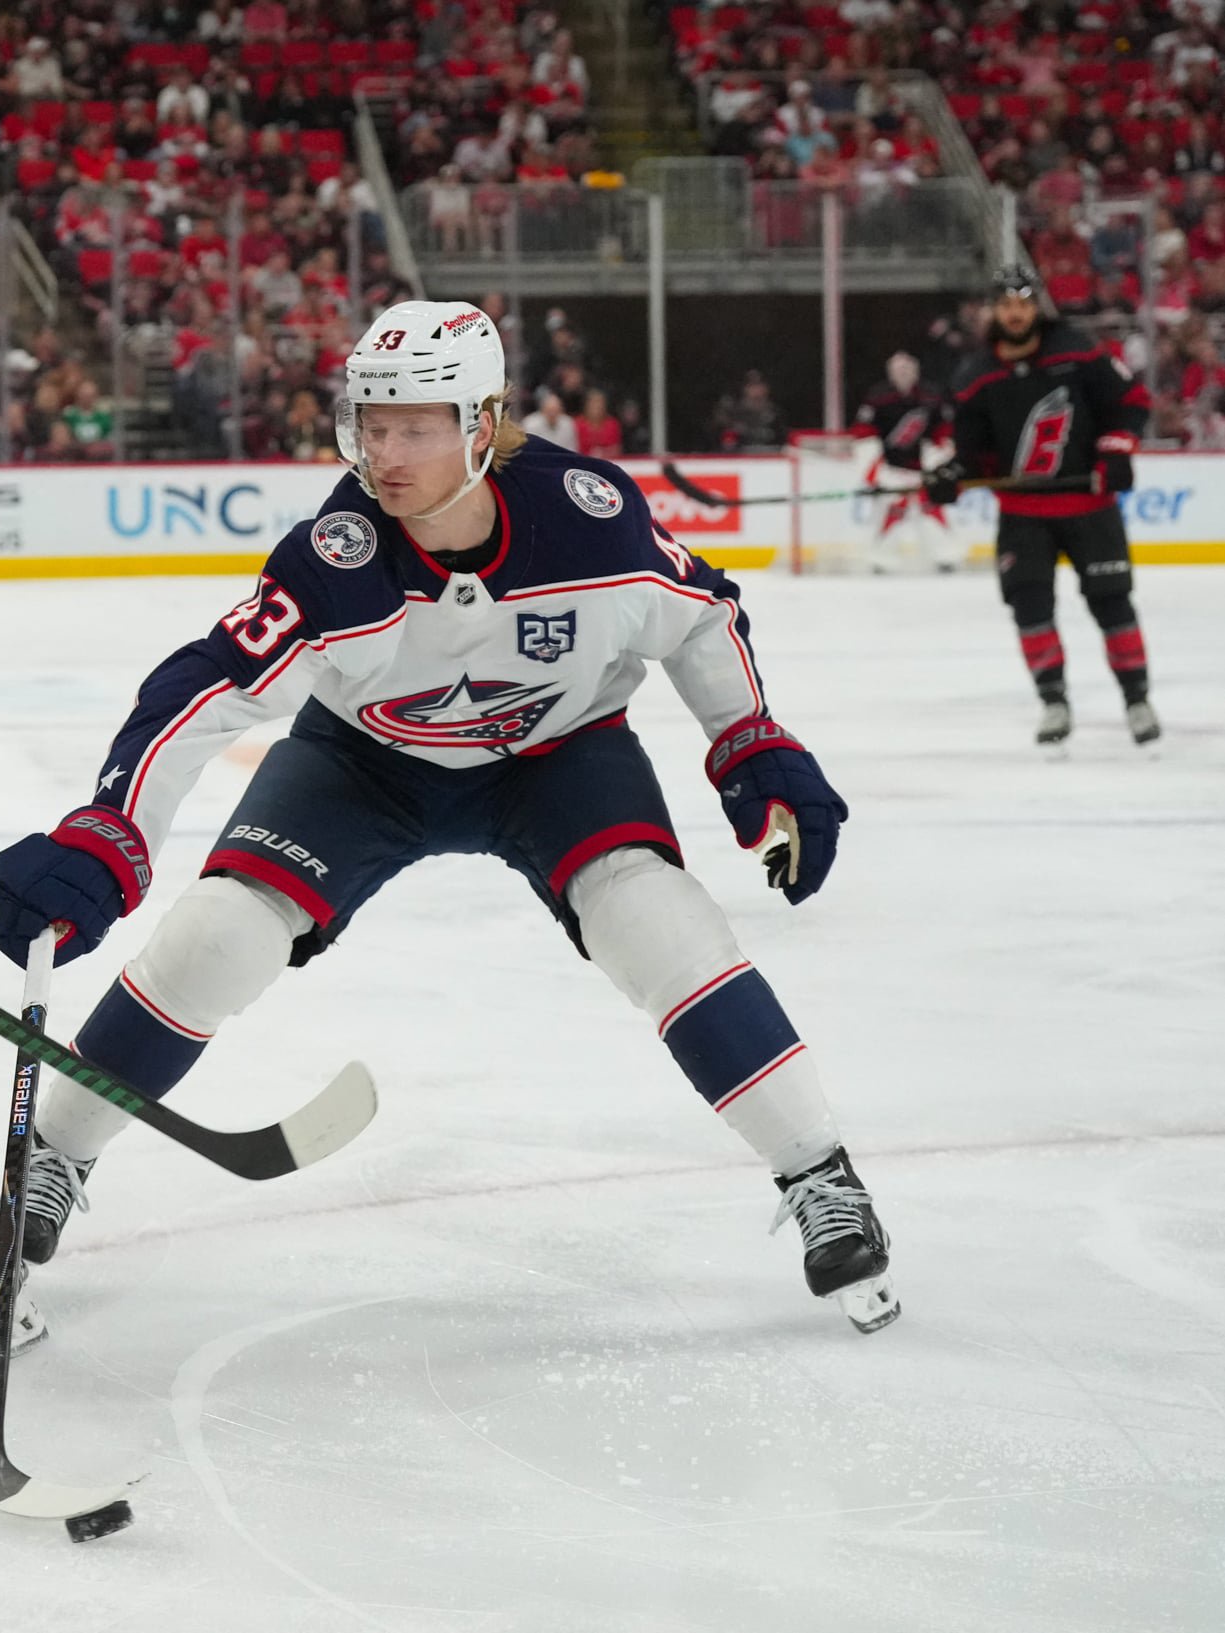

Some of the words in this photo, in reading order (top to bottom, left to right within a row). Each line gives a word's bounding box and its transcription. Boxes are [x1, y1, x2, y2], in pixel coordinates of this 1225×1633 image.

[373, 330, 407, 351] 43
[107, 484, 264, 537] UNC
[320, 516, 359, 533] COLUMBUS
[220, 572, 304, 660] 43
[523, 620, 571, 652] 25
[227, 824, 329, 880] BAUER
